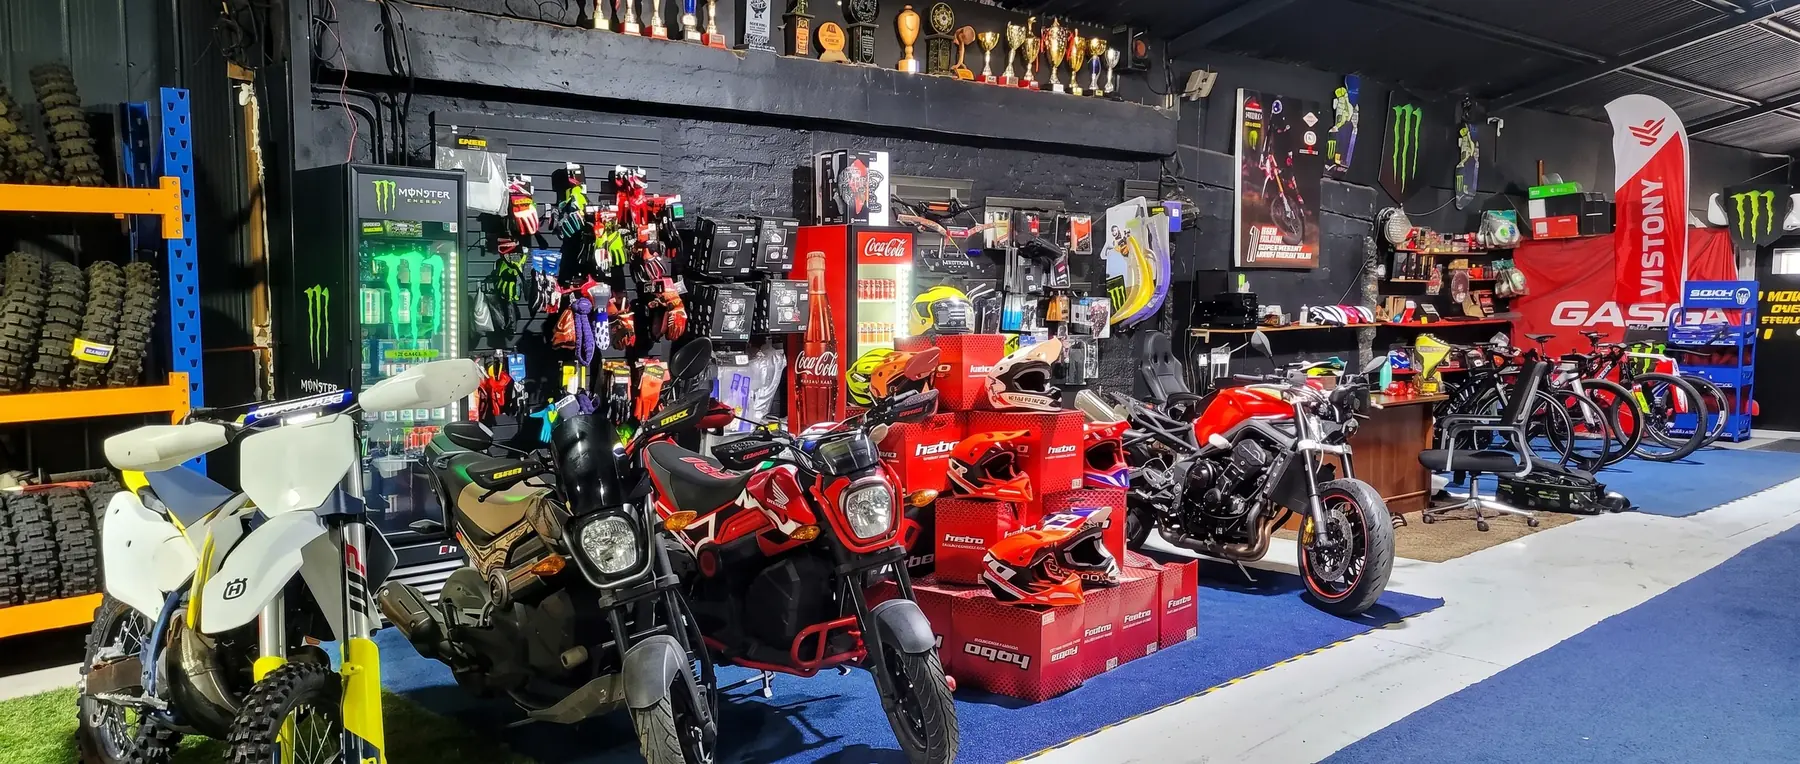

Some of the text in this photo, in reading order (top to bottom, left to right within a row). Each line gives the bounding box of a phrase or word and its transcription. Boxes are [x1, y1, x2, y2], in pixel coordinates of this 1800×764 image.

[398, 188, 451, 200] MONSTER
[864, 237, 907, 257] Coca-Cola
[1640, 178, 1665, 297] VISTONY
[1551, 300, 1753, 327] GASGA
[794, 350, 838, 377] Coca-Cola
